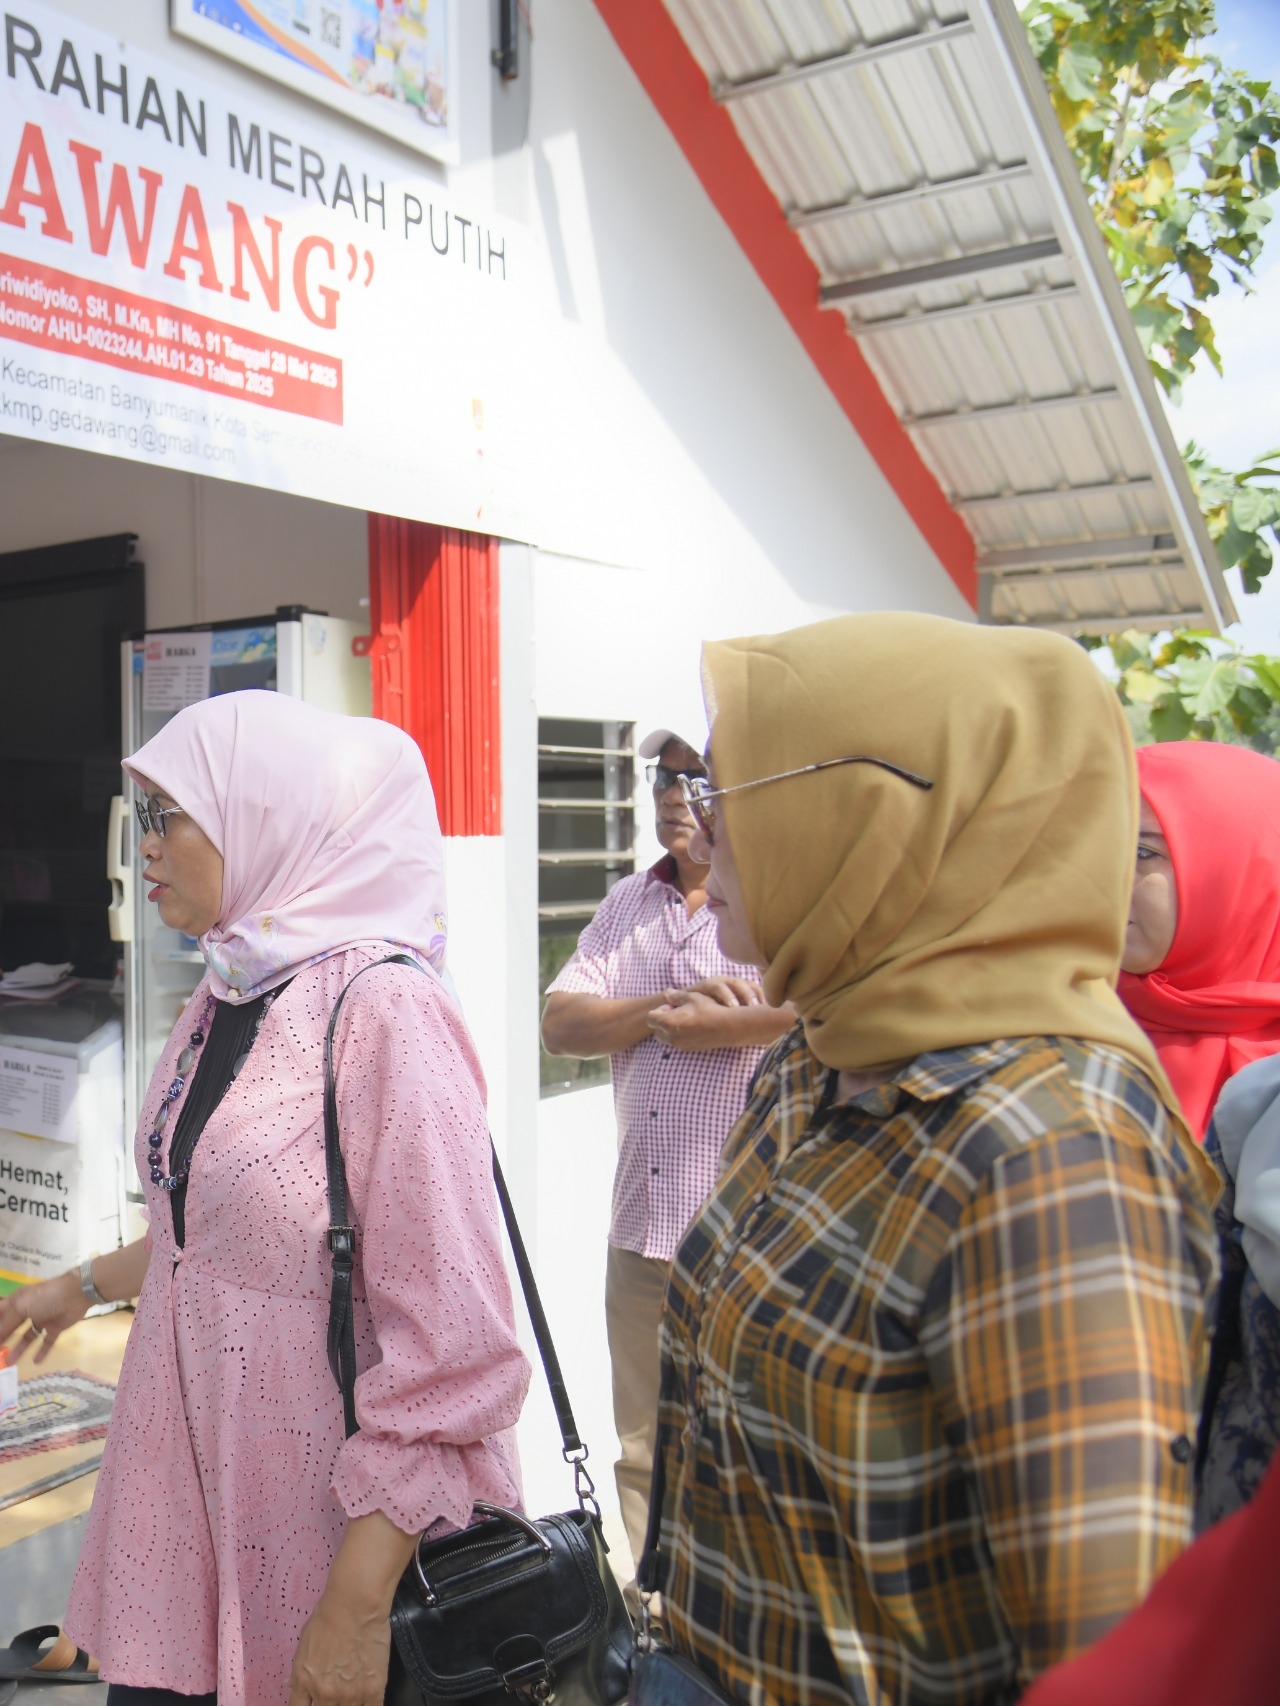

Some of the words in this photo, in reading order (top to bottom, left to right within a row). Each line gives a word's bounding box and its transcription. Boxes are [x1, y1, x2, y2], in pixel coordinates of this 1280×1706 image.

[227, 112, 386, 232] MERAH
[404, 192, 506, 281] PUTIH
[85, 294, 112, 324] SH,
[114, 302, 154, 338] M.Kn,
[156, 315, 180, 342] MH
[181, 323, 205, 349] No.
[205, 330, 221, 354] 91
[222, 335, 270, 371] Tanggal
[1, 357, 106, 402] Kecamatan
[110, 383, 210, 429] Banyumanik
[205, 357, 245, 390] Tahun
[0, 1159, 70, 1196] Hemat,
